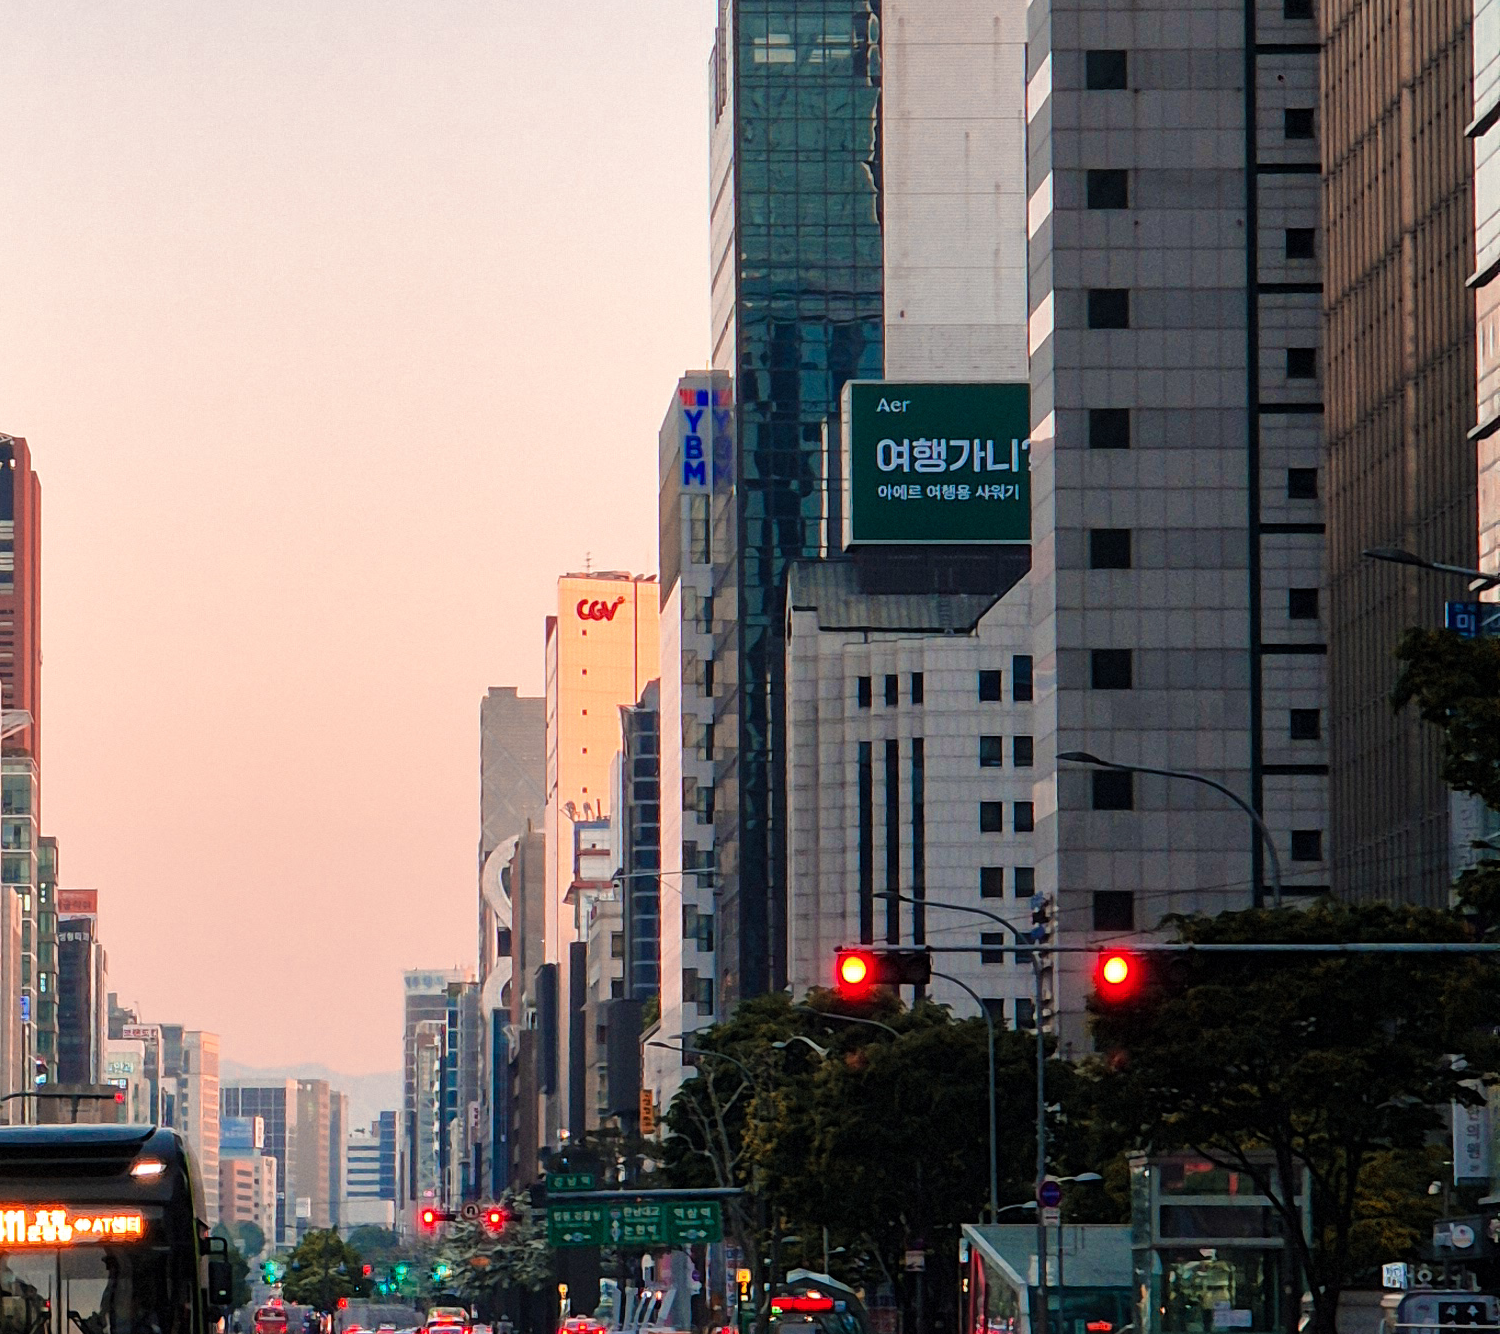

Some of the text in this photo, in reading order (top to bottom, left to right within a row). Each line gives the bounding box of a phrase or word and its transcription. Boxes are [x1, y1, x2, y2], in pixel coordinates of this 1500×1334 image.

[876, 397, 911, 413] Aer
[683, 409, 707, 486] YBM
[877, 483, 924, 501] 아에르
[926, 483, 971, 501] 여행용
[576, 597, 624, 622] CGV
